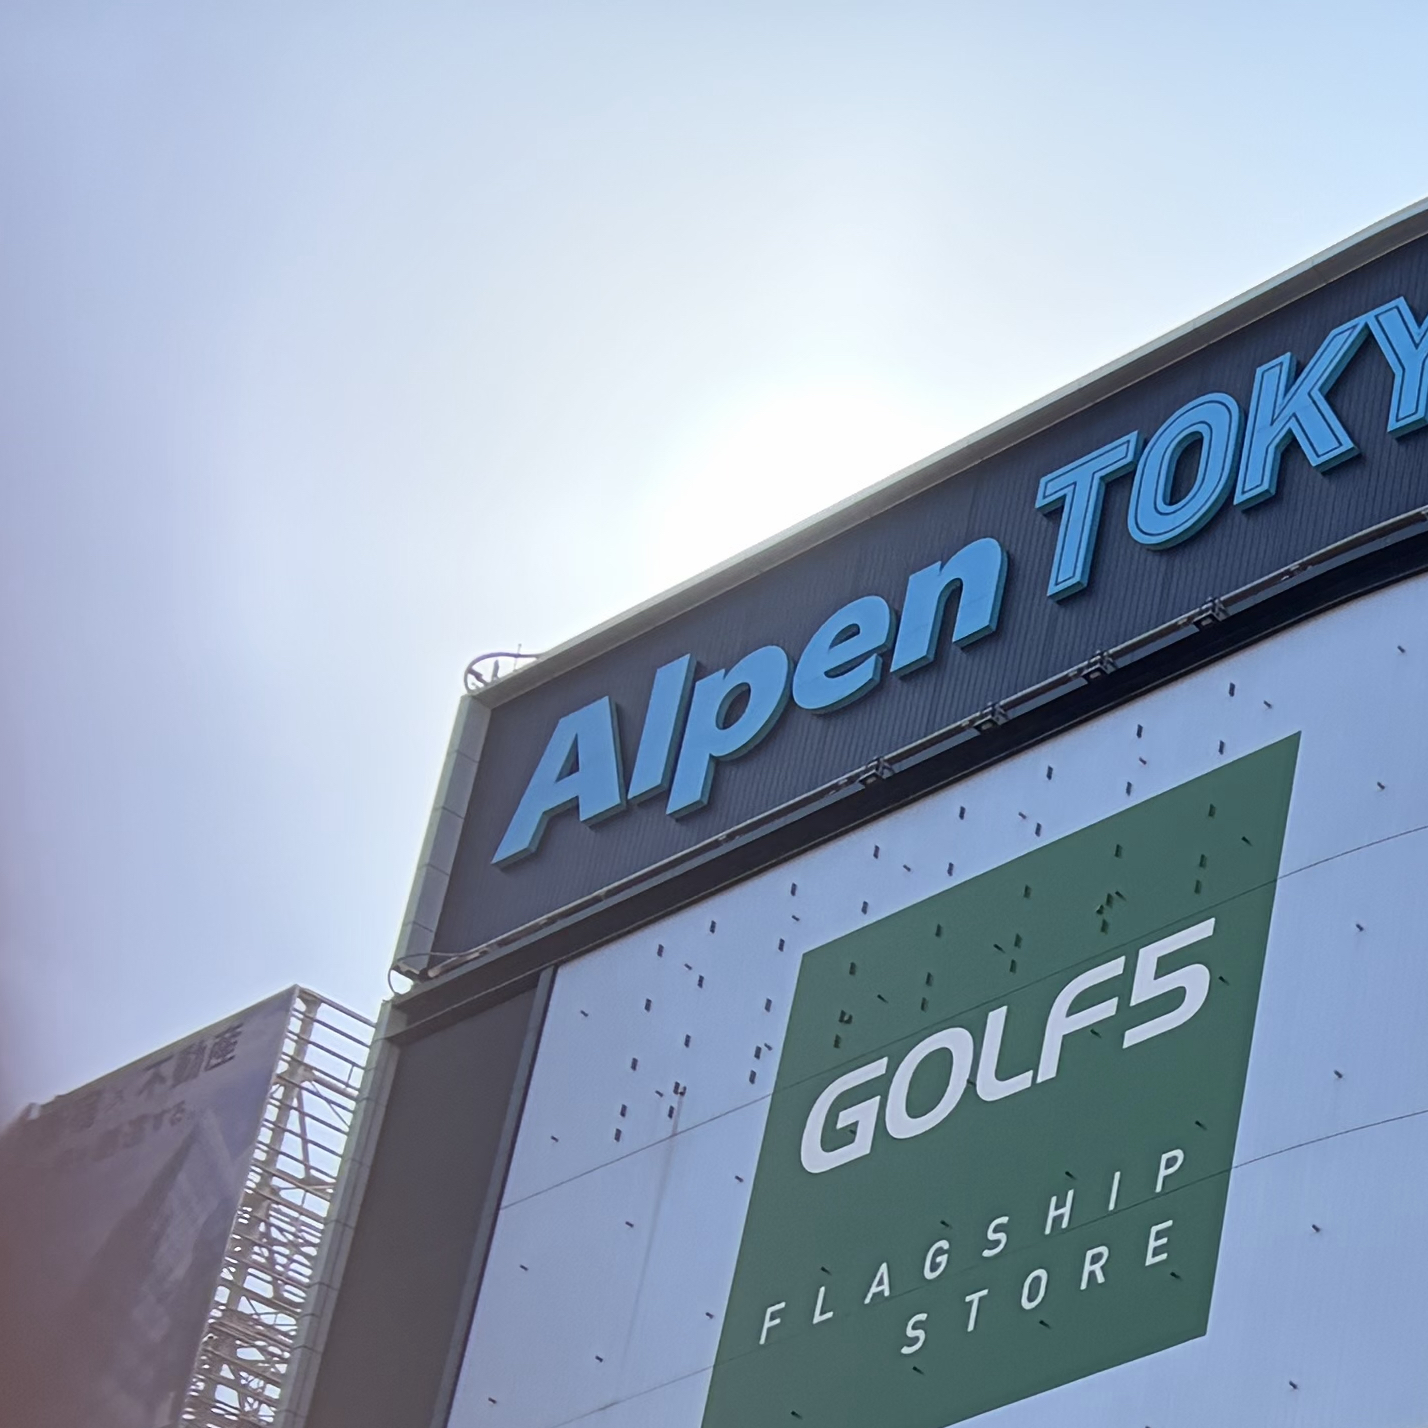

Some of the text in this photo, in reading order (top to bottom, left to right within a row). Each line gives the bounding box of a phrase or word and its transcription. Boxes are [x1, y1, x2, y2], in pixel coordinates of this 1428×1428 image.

[492, 535, 1008, 868] Alpen
[800, 917, 1216, 1174] GOLF5
[758, 1147, 1186, 1346] FLAGSHIP
[900, 1219, 1174, 1356] STORE
